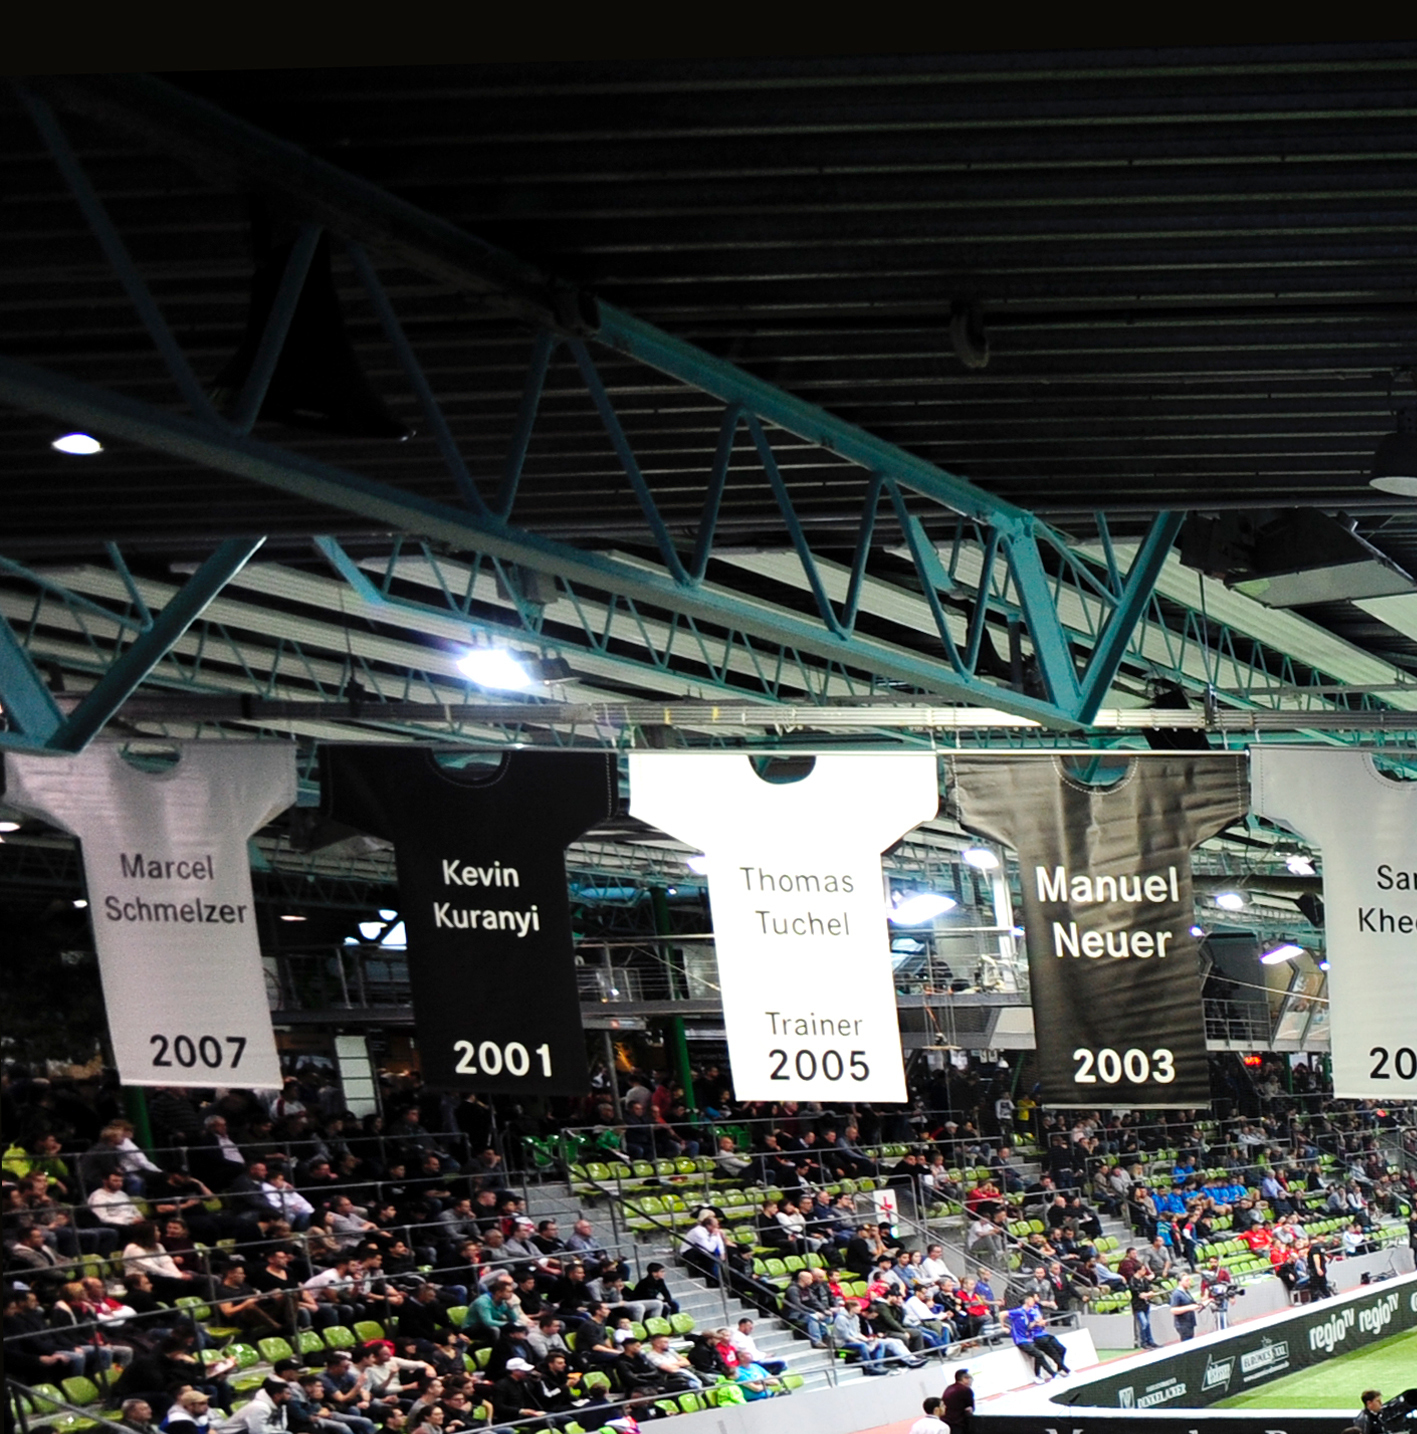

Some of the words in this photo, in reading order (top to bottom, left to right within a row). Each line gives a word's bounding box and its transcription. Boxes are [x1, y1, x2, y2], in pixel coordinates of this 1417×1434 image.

[119, 852, 214, 881] Marcel
[442, 858, 520, 888] Kevin
[739, 866, 854, 893] Thomas
[1036, 865, 1179, 903] Manuel
[104, 895, 248, 925] Schmelzer
[433, 900, 540, 934] Kuranyi
[755, 909, 850, 936] Tuchel
[1053, 920, 1172, 958] Neuer
[765, 1011, 863, 1037] Trainer
[149, 1034, 248, 1069] 2007
[453, 1039, 554, 1078] 2001
[768, 1048, 870, 1081] 2005
[1073, 1047, 1175, 1083] 2003
